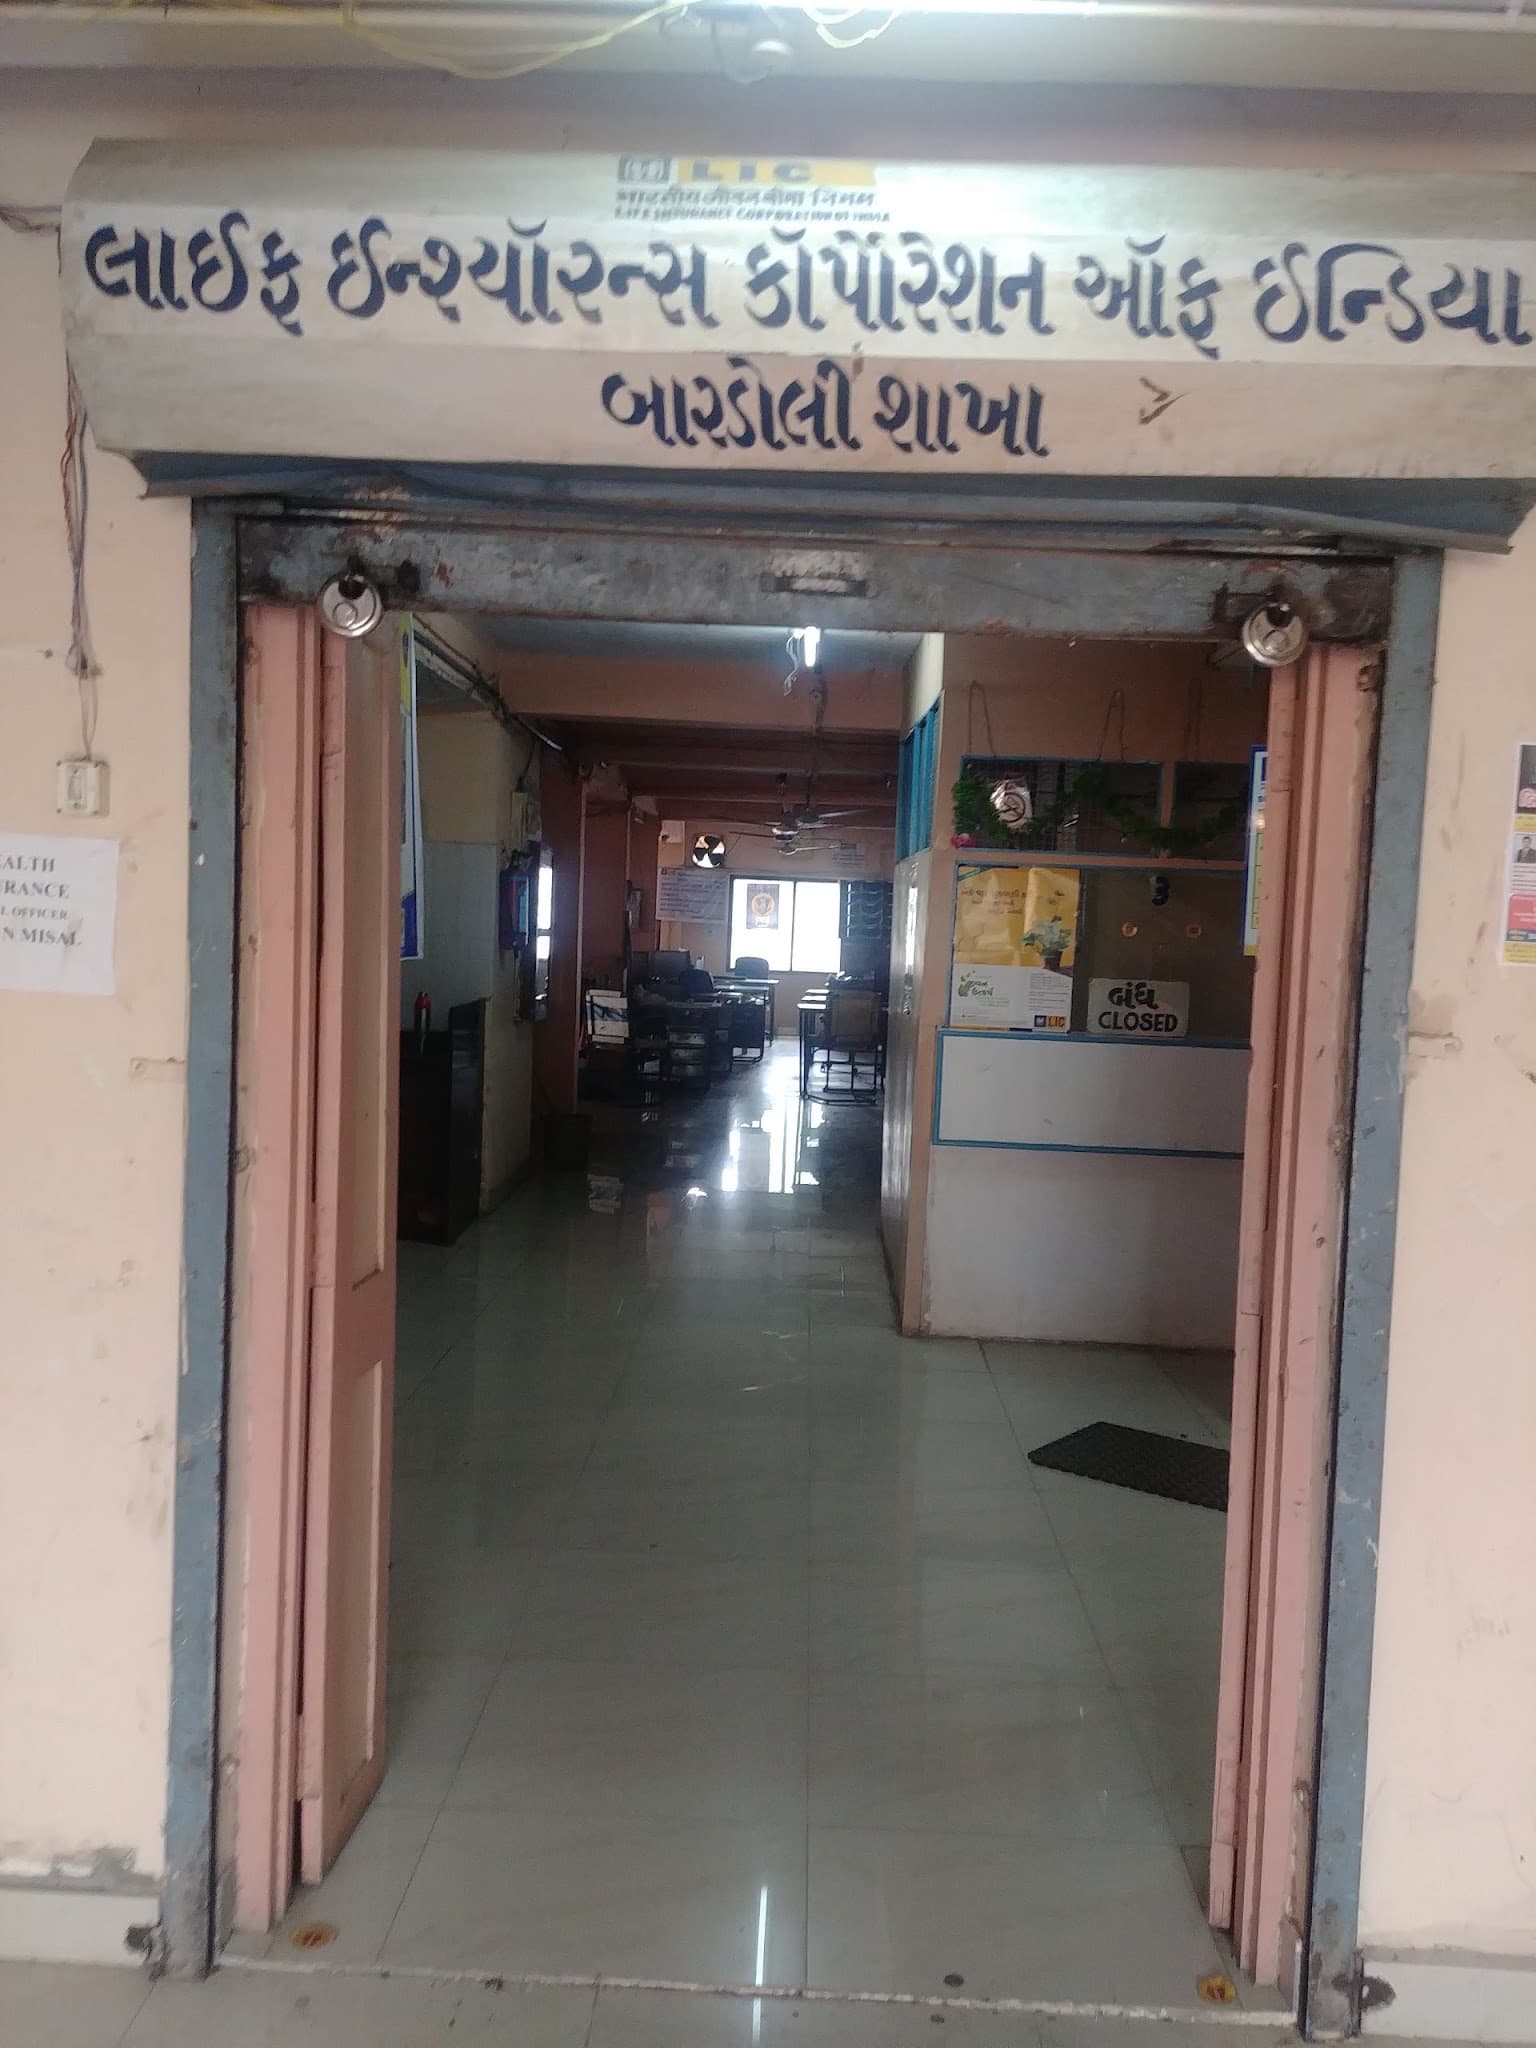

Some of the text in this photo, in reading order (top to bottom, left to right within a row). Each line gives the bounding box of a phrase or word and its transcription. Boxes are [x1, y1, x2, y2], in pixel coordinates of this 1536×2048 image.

[691, 159, 812, 183] LIC
[85, 210, 304, 337] લાઈફ
[601, 356, 1049, 457] બારડોલી શાખા
[0, 854, 56, 873] ALTH
[0, 879, 71, 899] RANCE
[1108, 981, 1159, 1010] બંધ
[1098, 1011, 1178, 1033] CLOSED
